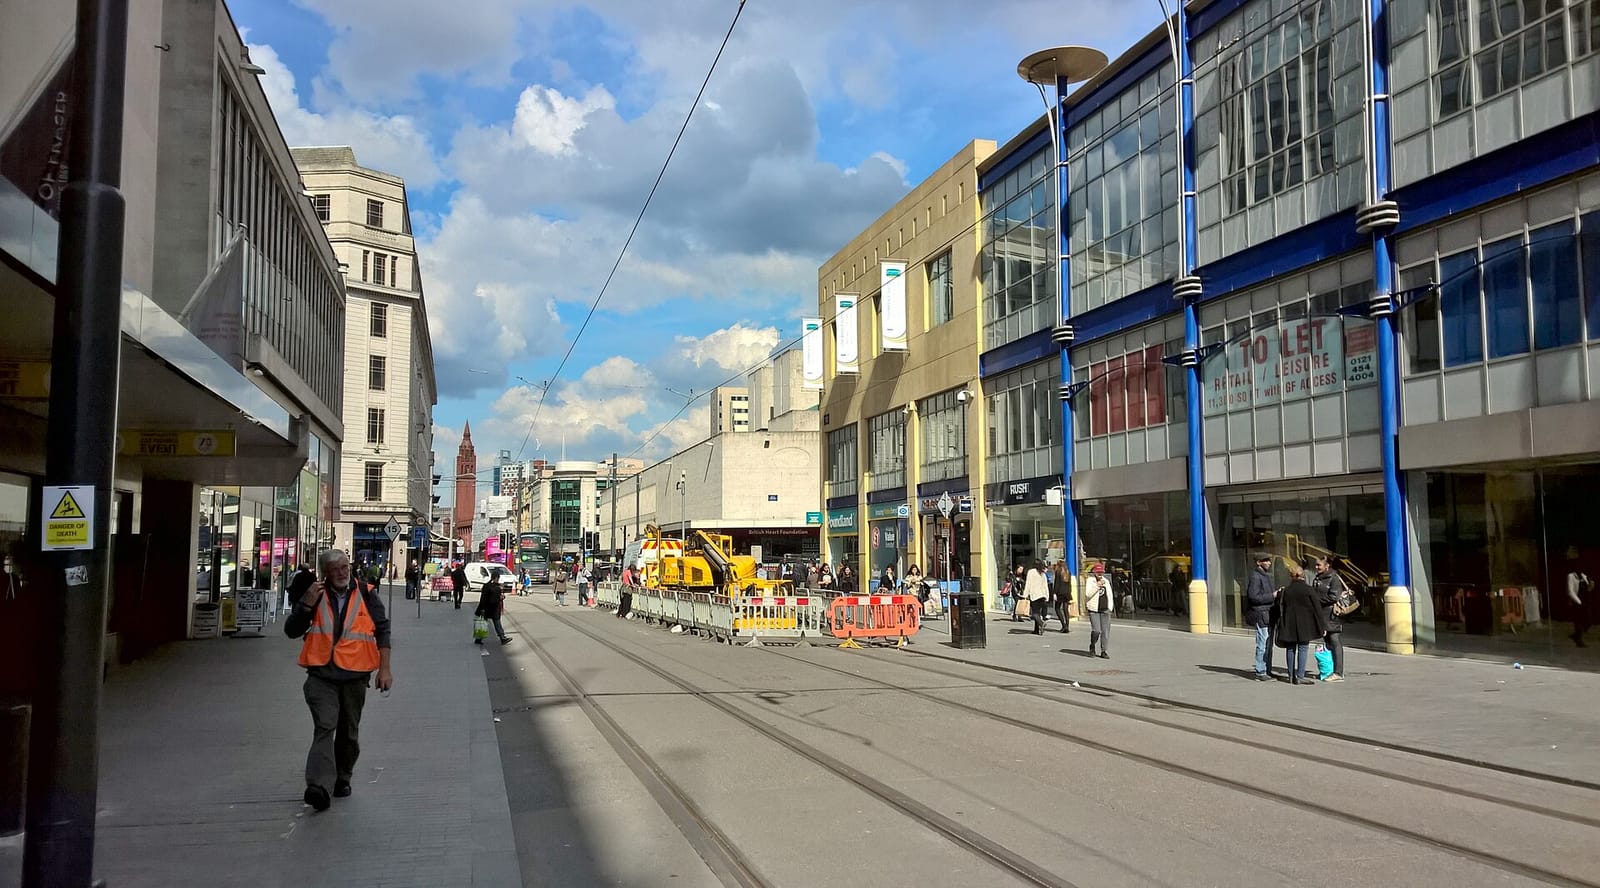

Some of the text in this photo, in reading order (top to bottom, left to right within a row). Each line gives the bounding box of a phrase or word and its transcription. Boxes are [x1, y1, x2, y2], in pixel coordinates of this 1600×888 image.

[48, 91, 66, 165] FRASER
[1240, 335, 1268, 368] TO
[1281, 318, 1327, 359] LET
[1275, 352, 1329, 378] LEISURE
[1350, 354, 1371, 365] 0121
[1351, 363, 1371, 373] 454
[1348, 371, 1374, 382] 4004
[1237, 391, 1247, 402] SQ
[1285, 381, 1297, 393] GF
[1300, 373, 1337, 390] ACCESS
[1009, 482, 1030, 496] RUSH
[387, 525, 398, 533] 15
